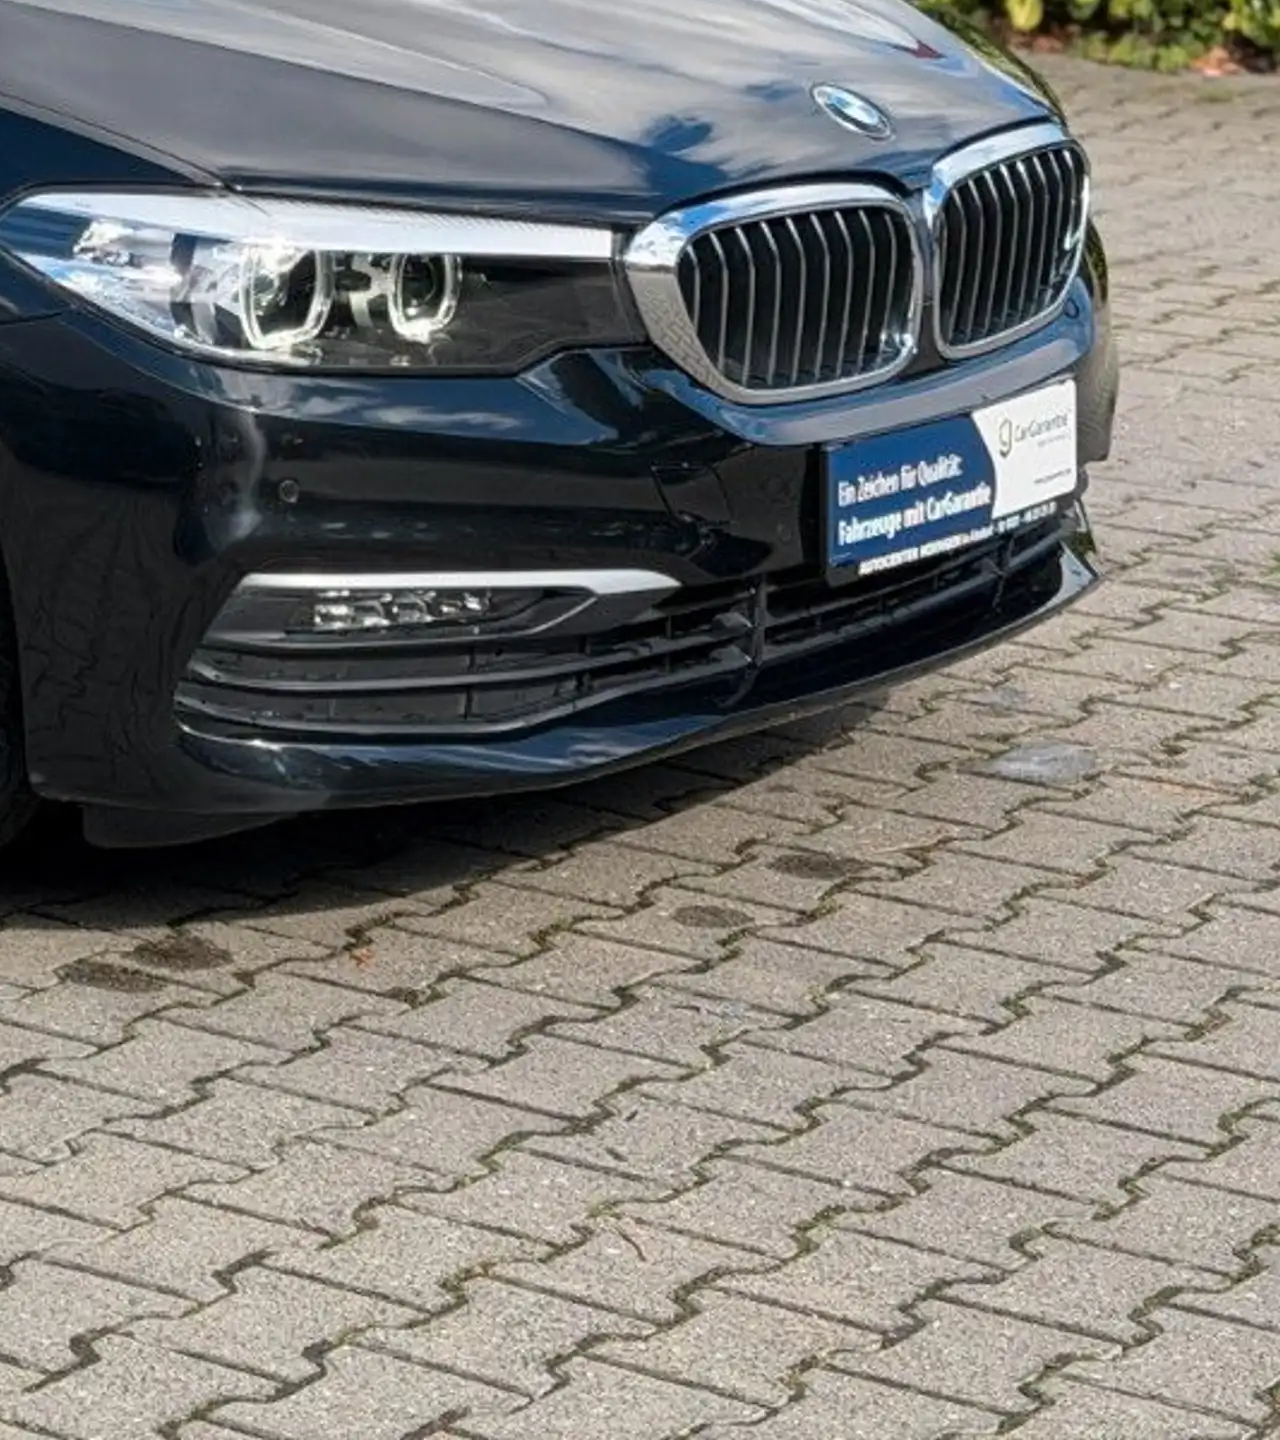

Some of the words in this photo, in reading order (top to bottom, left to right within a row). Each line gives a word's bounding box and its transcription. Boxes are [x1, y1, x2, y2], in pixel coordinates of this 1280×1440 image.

[838, 480, 856, 508] Ein
[857, 470, 900, 502] Zeichen
[901, 464, 917, 491] für
[838, 511, 902, 546] Fahrzeuge
[903, 500, 926, 529] mit
[927, 481, 992, 521] CarGarantie
